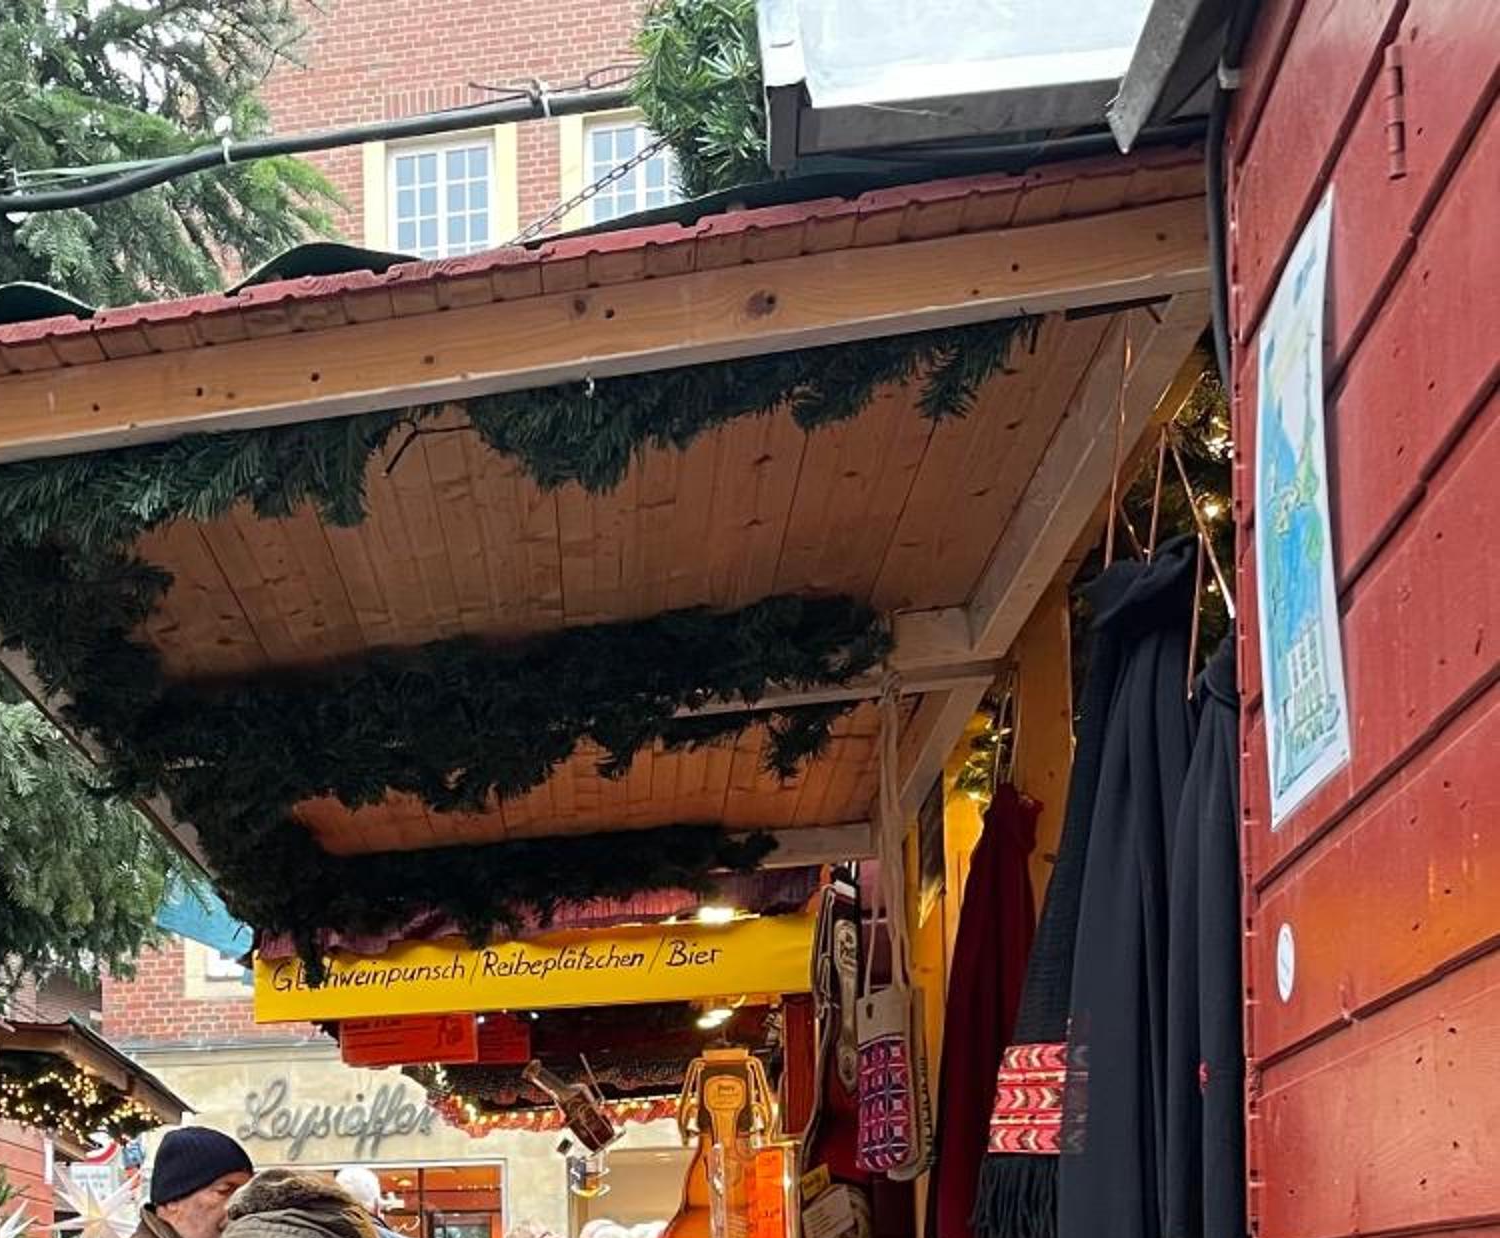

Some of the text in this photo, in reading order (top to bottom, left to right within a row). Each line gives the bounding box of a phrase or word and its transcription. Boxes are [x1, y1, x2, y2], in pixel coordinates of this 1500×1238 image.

[271, 953, 465, 992] Glhweinpunsch
[665, 939, 724, 968] Bier
[236, 1077, 438, 1162] Leysieffer
